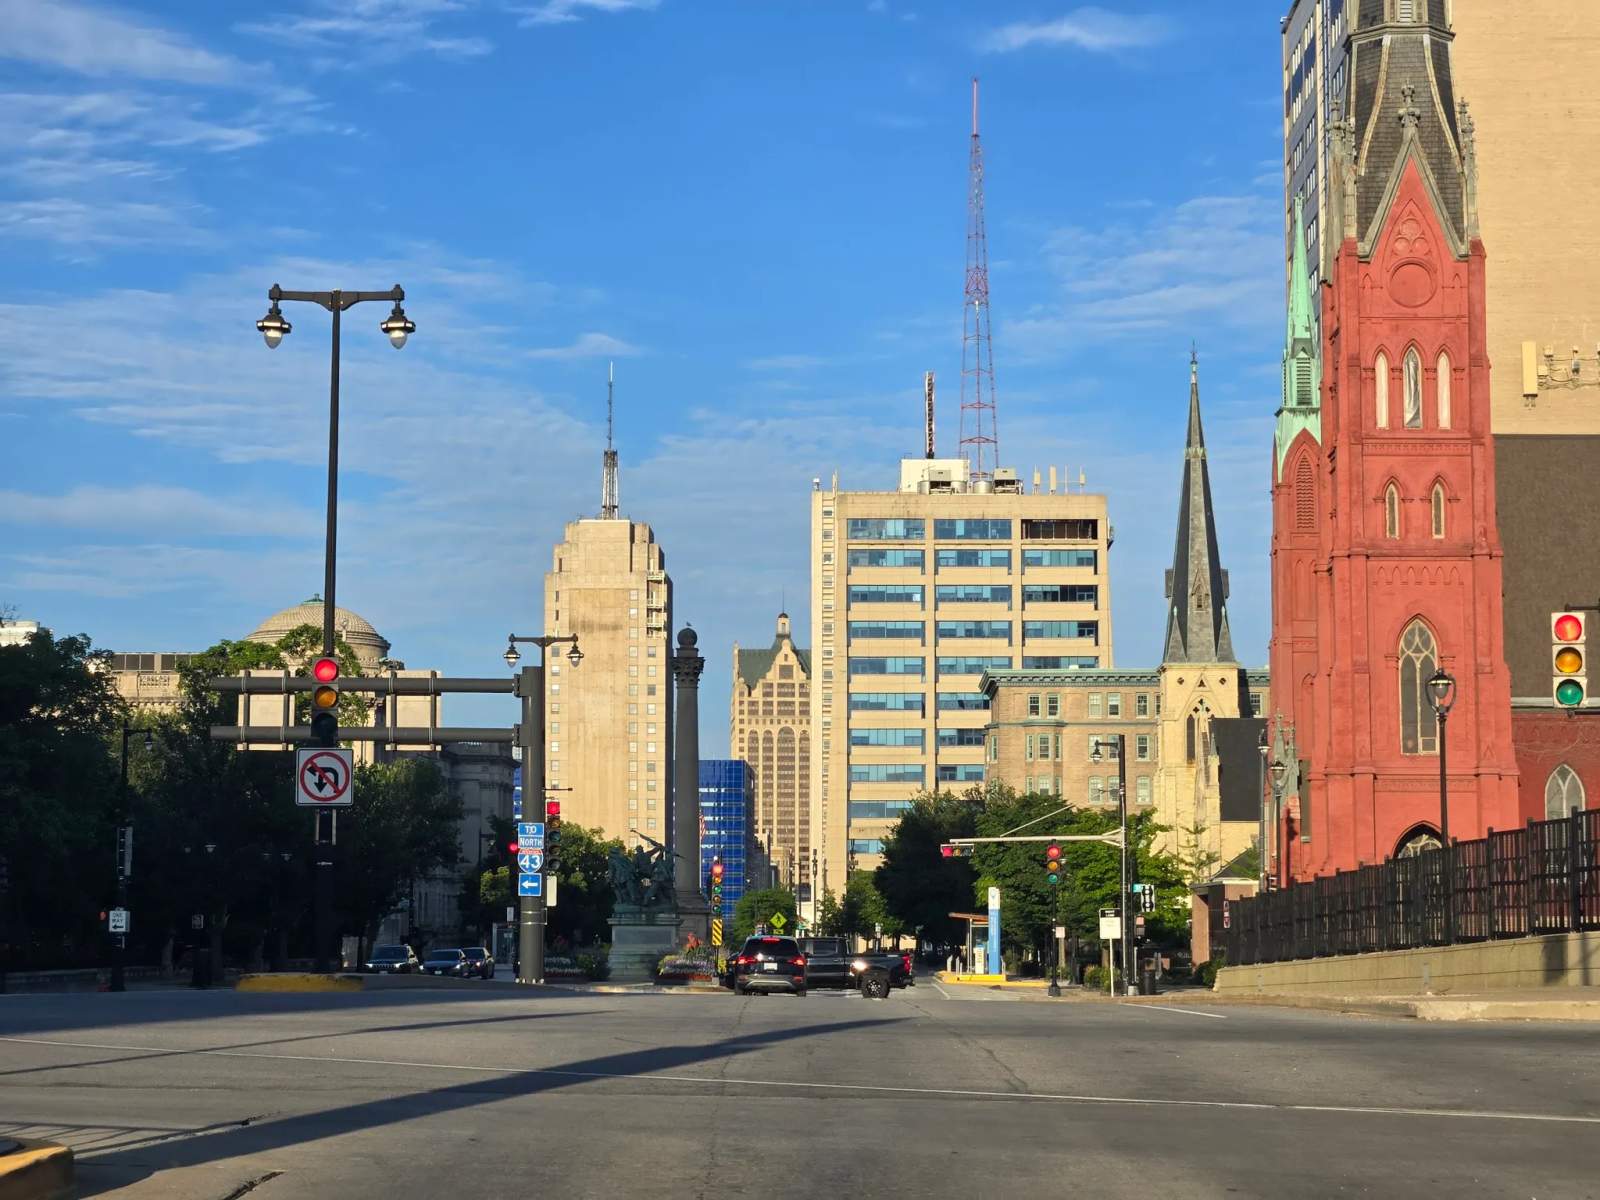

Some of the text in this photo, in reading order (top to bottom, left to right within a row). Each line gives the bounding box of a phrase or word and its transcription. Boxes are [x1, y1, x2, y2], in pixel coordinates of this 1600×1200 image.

[525, 825, 537, 834] TO
[519, 837, 543, 847] NORTH
[520, 855, 540, 868] 43
